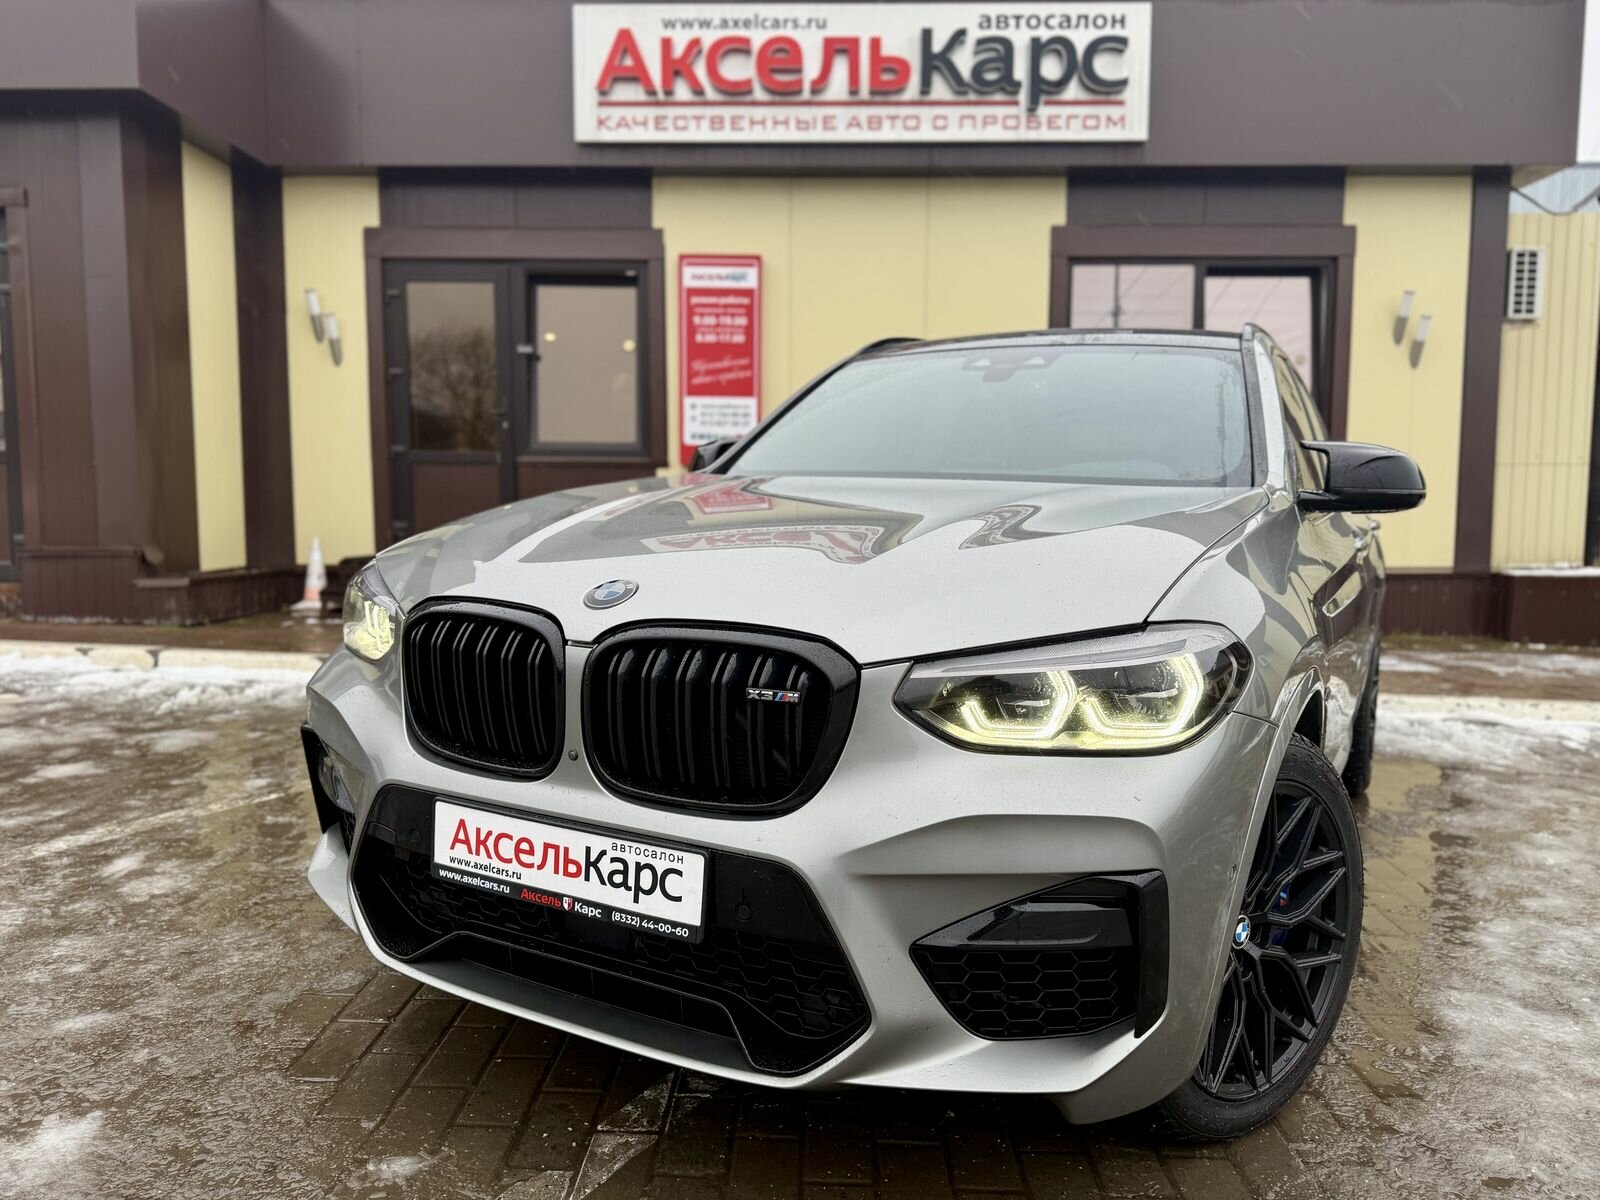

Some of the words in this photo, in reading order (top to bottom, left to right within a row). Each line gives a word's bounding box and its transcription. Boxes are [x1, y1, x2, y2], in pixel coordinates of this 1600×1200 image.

[661, 14, 827, 31] www.axelcars.ru
[977, 12, 1127, 31] автосалон
[596, 114, 837, 132] КАЧЕСТВЕННЫЕ
[845, 114, 921, 131] АВТО
[931, 114, 949, 131] С
[958, 114, 1126, 131] ПРОБЕГОМ
[611, 842, 684, 865] автосалон
[449, 856, 522, 881] www.axelcars.ru
[438, 868, 510, 894] www.axelcars.ru
[520, 888, 562, 908] Аксель
[574, 901, 602, 918] Карс
[611, 911, 640, 928] (8332)
[641, 919, 689, 938] 44-00-60
